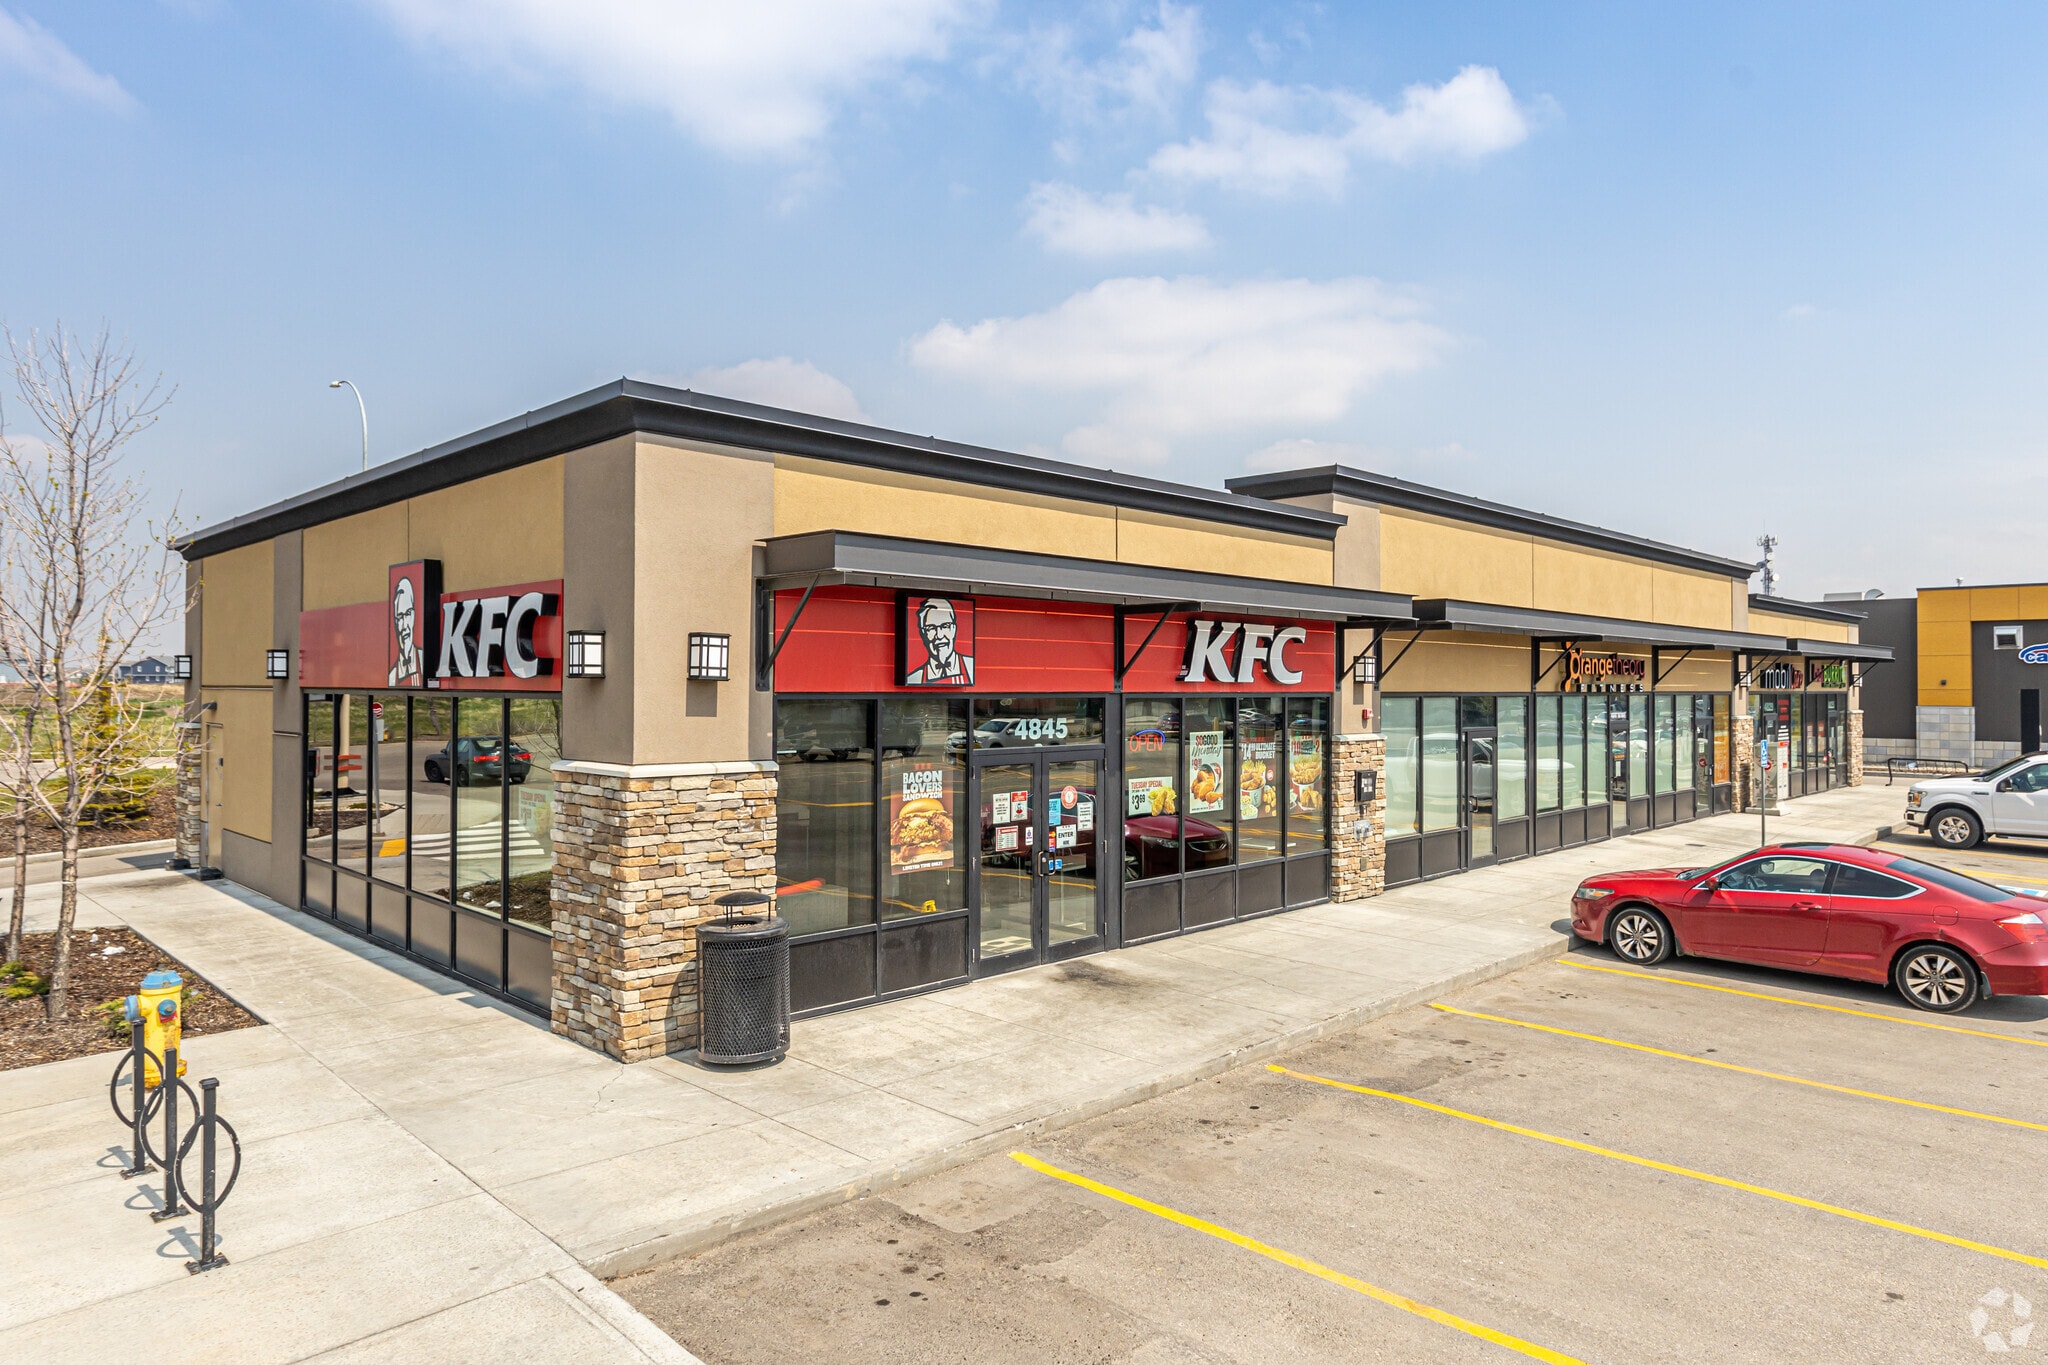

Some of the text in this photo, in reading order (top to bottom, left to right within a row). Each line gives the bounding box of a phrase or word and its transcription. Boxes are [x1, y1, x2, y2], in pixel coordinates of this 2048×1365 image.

[435, 591, 544, 679] KFC
[1184, 619, 1307, 685] KFC
[1580, 683, 1644, 692] FITNESS
[1014, 717, 1068, 740] 4845
[1129, 734, 1163, 752] OPEN
[902, 770, 943, 785] BACON
[903, 781, 943, 794] LOVERS
[1058, 831, 1073, 839] ENTER
